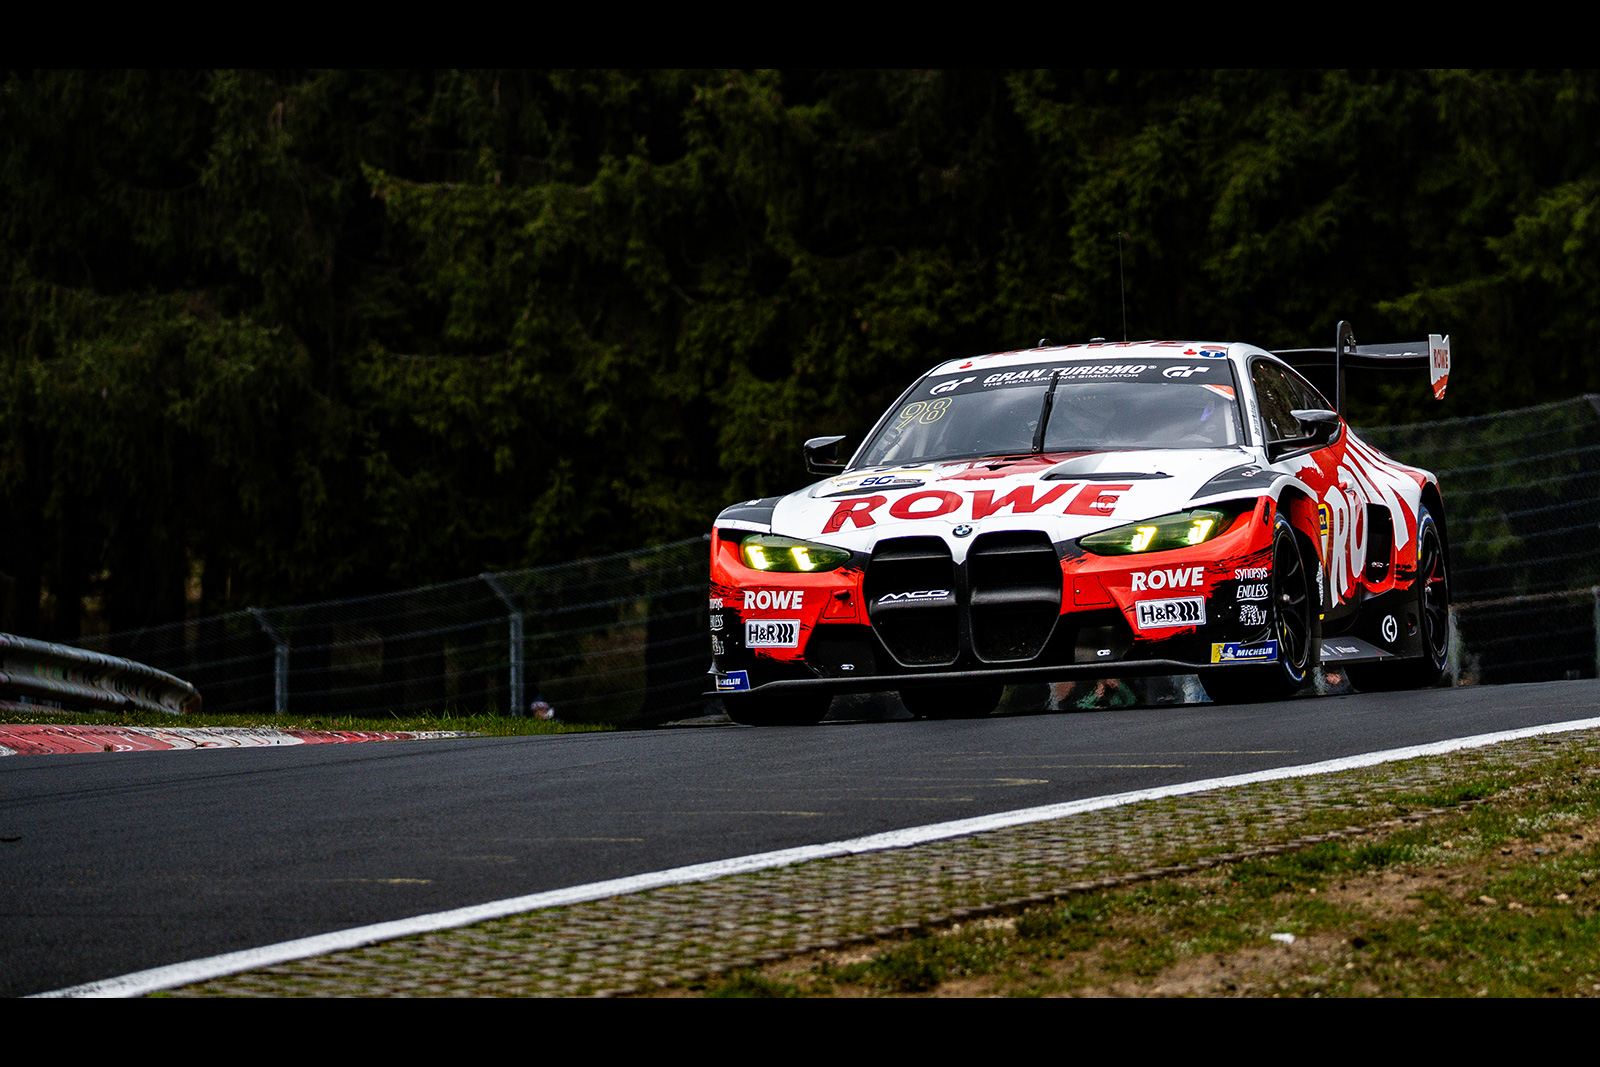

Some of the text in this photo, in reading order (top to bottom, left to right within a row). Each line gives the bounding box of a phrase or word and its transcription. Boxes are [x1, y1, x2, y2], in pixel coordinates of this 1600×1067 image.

[1433, 349, 1448, 369] ROWE
[983, 368, 1047, 384] GRAN
[896, 397, 952, 429] 98
[821, 483, 1134, 534] ROWE
[1130, 566, 1205, 592] ROWE
[1234, 567, 1268, 581] SYNOPSYS
[743, 590, 804, 609] ROWE
[1236, 584, 1268, 599] ENDLESS
[1140, 604, 1178, 623] H&R
[748, 624, 776, 643] H&R
[1236, 648, 1273, 657] MICHELIN
